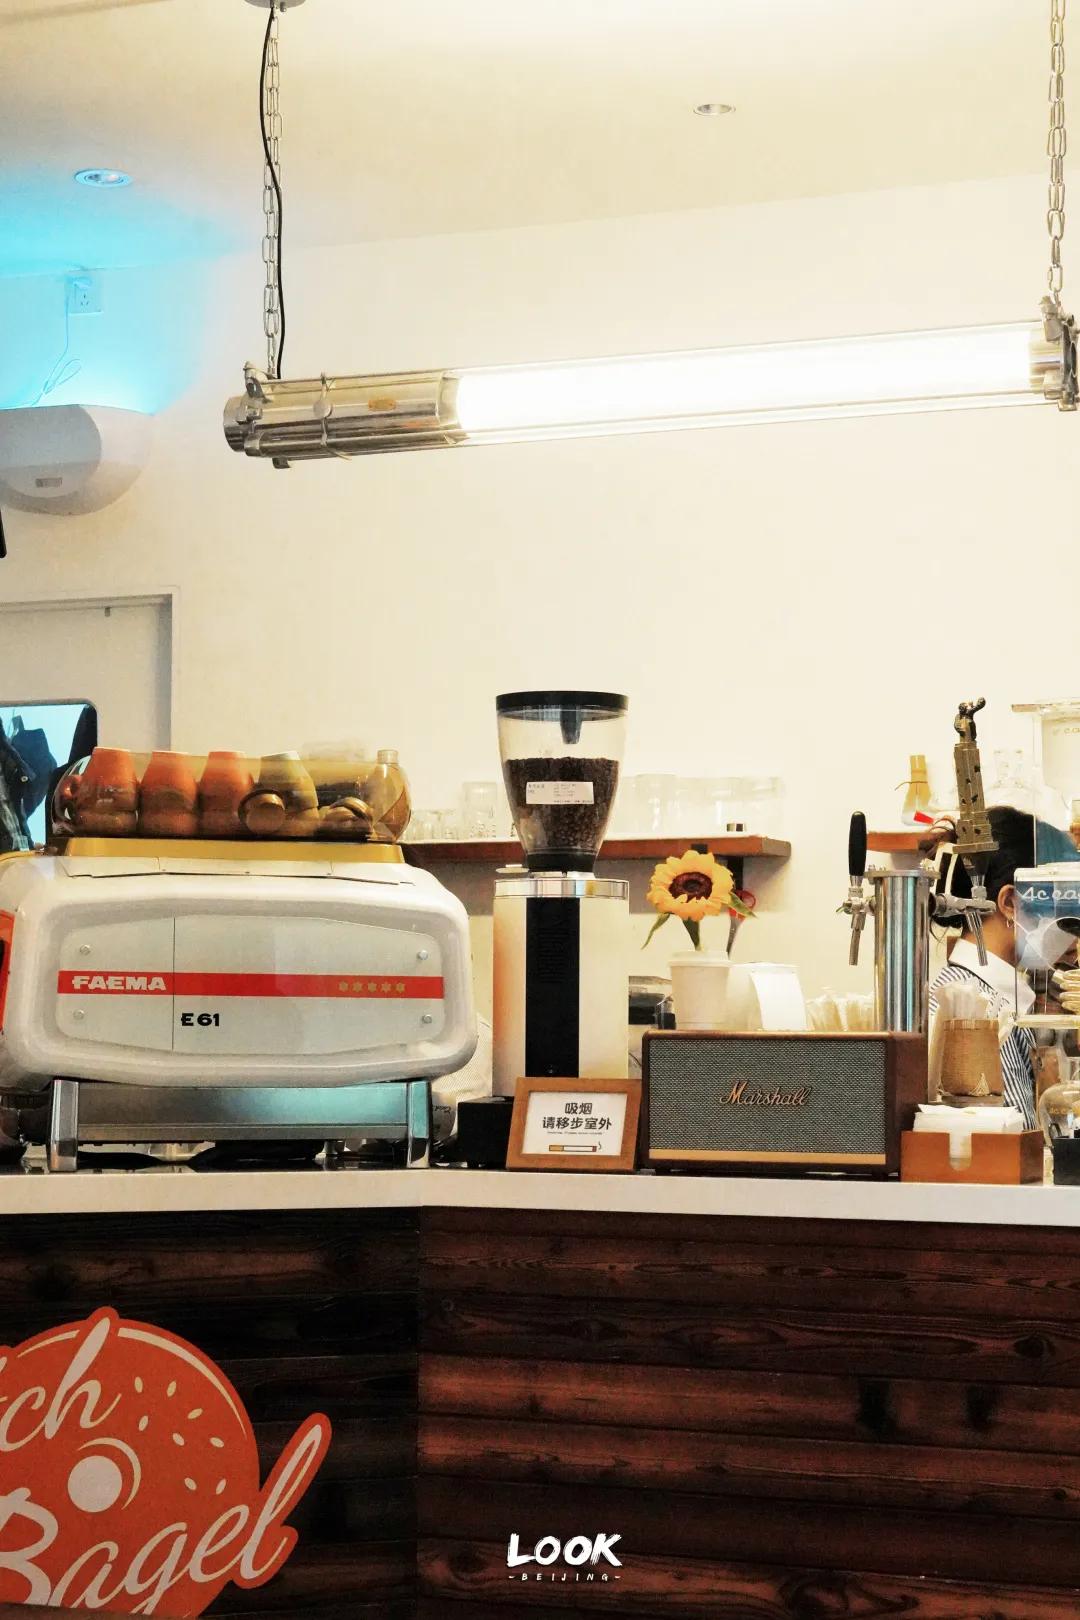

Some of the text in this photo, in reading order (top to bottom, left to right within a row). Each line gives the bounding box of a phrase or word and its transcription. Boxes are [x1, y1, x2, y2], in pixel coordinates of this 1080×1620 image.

[72, 975, 167, 991] FAEMA
[720, 1080, 812, 1106] Marshall
[564, 1102, 593, 1115] 吸烟
[542, 1116, 612, 1130] 请移步室外
[0, 1317, 122, 1452] ch
